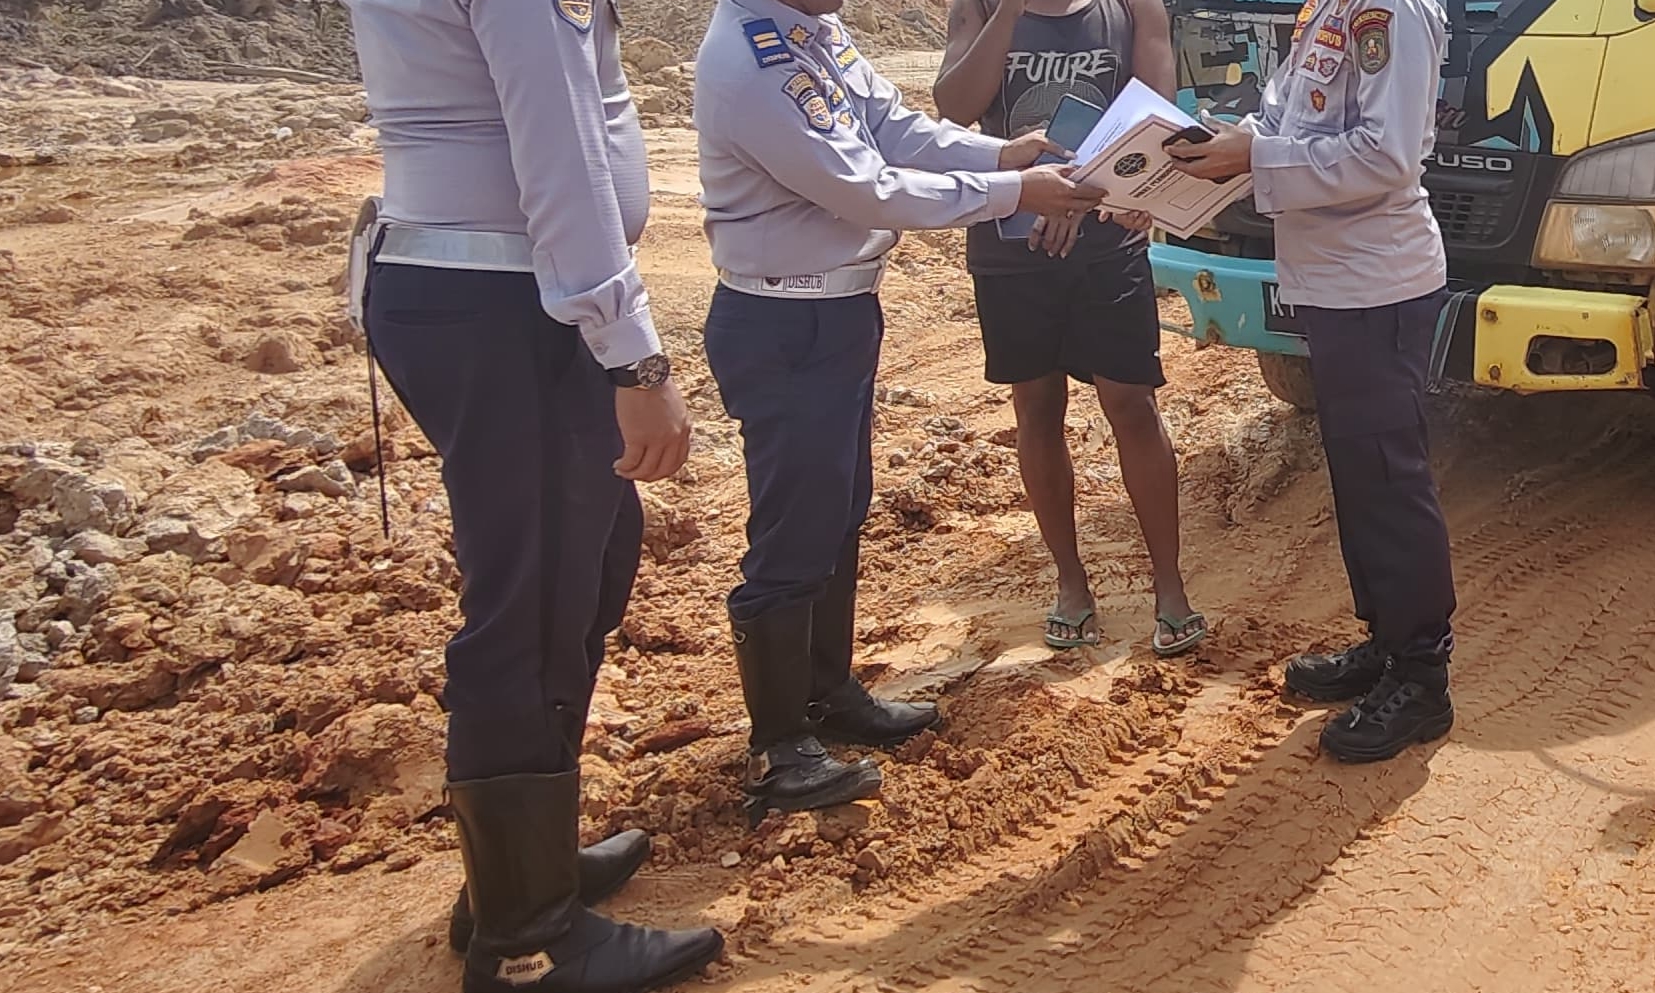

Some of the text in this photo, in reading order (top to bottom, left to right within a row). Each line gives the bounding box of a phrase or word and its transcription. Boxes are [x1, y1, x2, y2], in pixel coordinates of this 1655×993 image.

[1006, 48, 1115, 89] FUTURE
[788, 275, 823, 289] DISHUB
[506, 960, 544, 975] DISHUB
